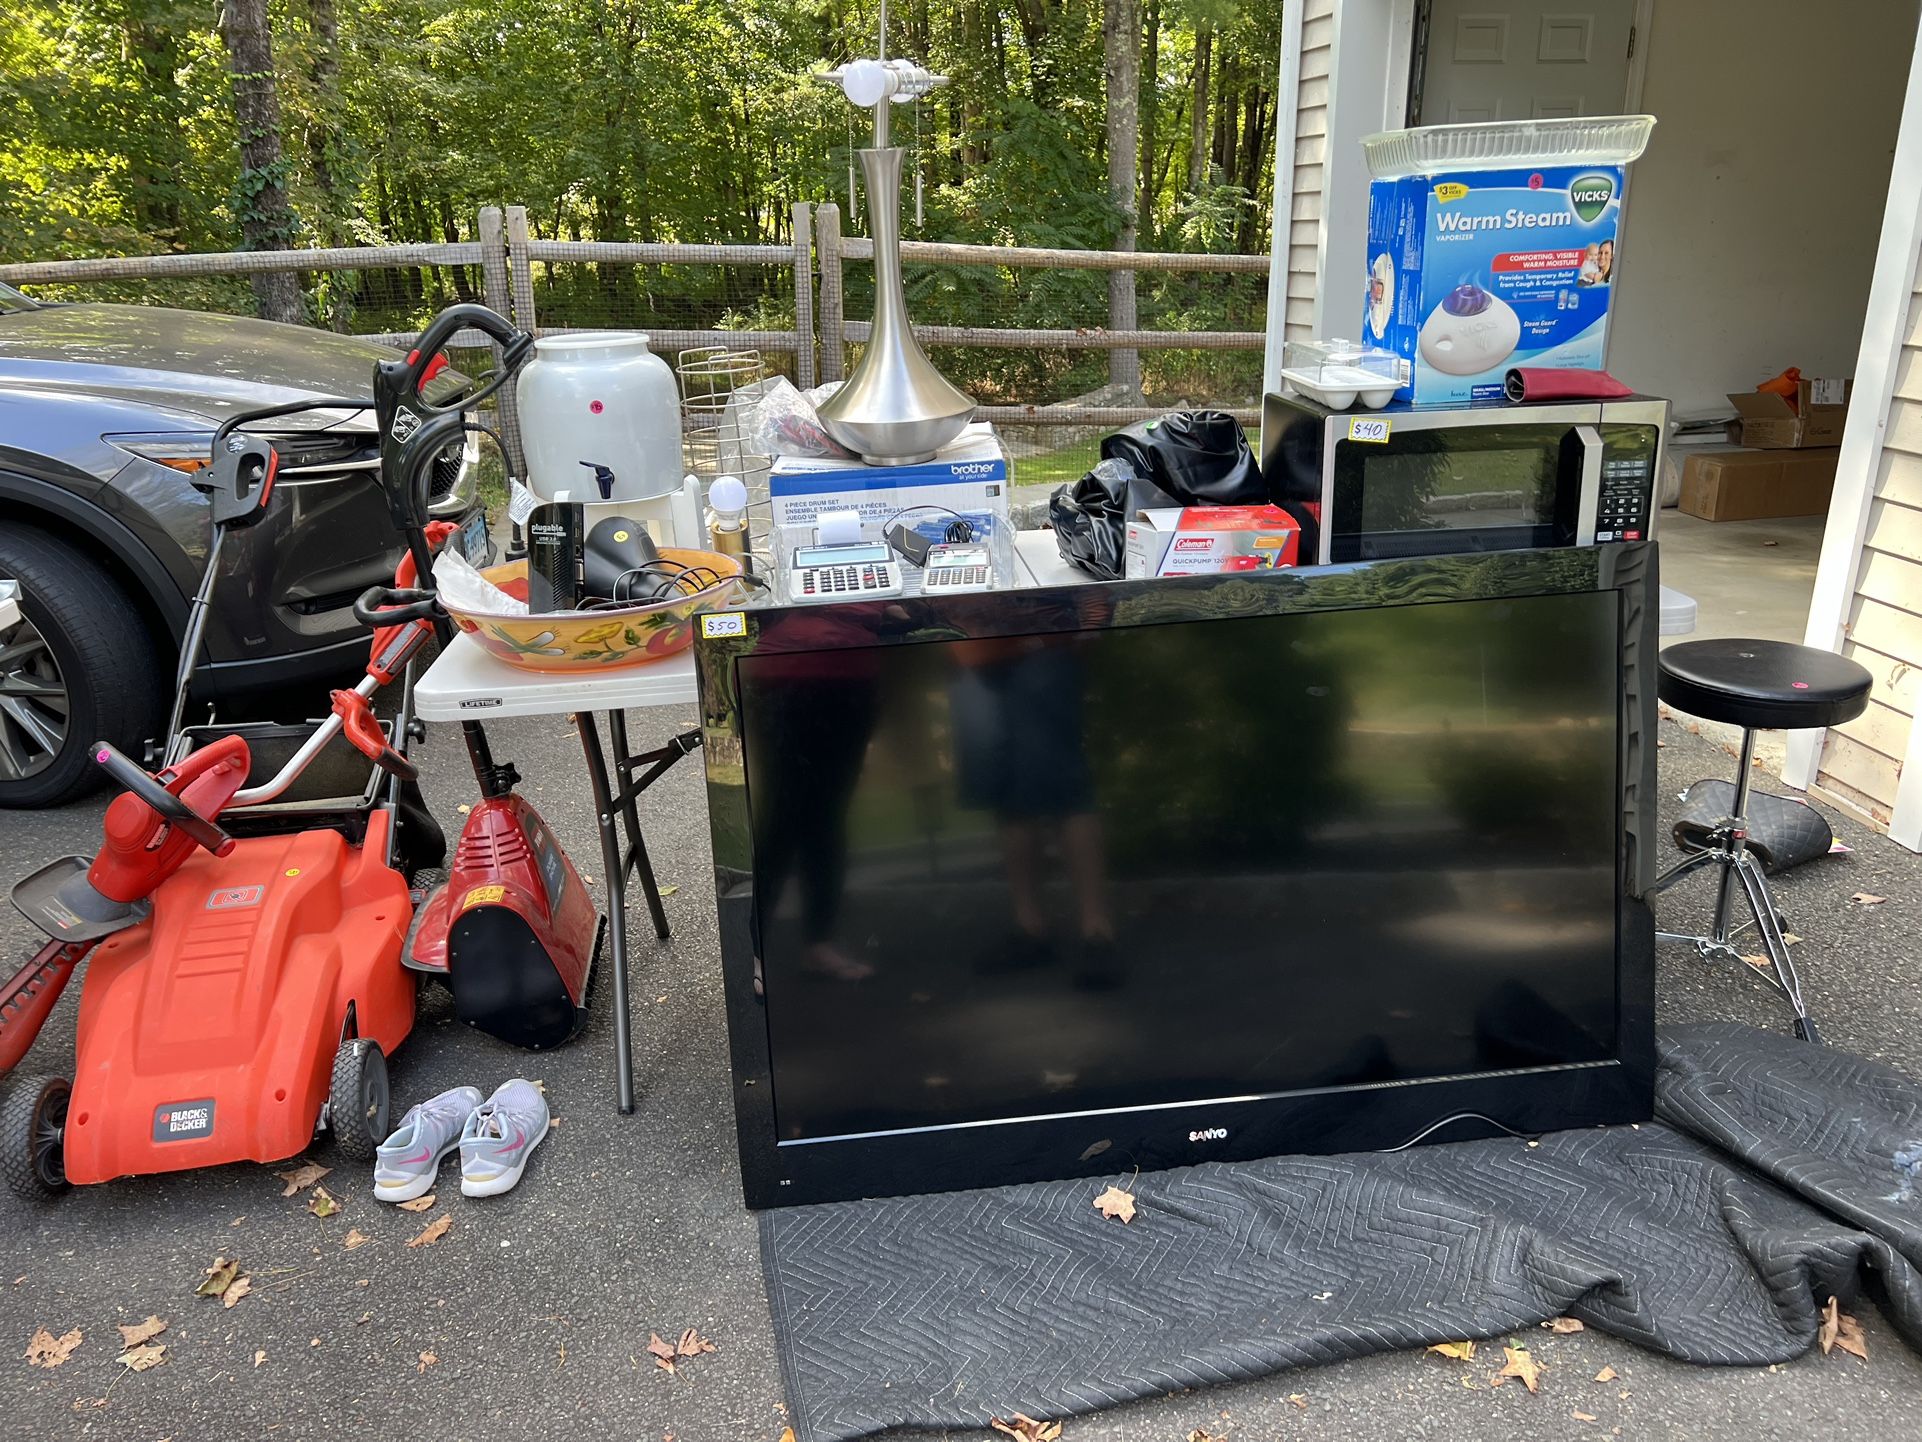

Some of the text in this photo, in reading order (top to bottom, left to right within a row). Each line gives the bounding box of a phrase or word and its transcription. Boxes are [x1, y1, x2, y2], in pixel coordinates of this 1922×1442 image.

[1439, 186, 1448, 195] $3
[1572, 191, 1607, 202] VICKS
[1436, 208, 1571, 232] Warm Steam
[1436, 234, 1474, 242] VAPORIZER
[1509, 251, 1579, 262] COMFORTING, VISIBLE
[1546, 259, 1578, 267] MOISTURE
[1354, 423, 1382, 436] $40
[951, 463, 995, 475] brother
[531, 524, 564, 533] plugable
[1177, 539, 1205, 548] Coleman
[708, 620, 737, 632] $50
[462, 700, 497, 708] LIFETIME
[171, 1108, 208, 1121] BLACK&
[170, 1119, 206, 1132] DECKER
[1189, 1128, 1227, 1141] SANYO
